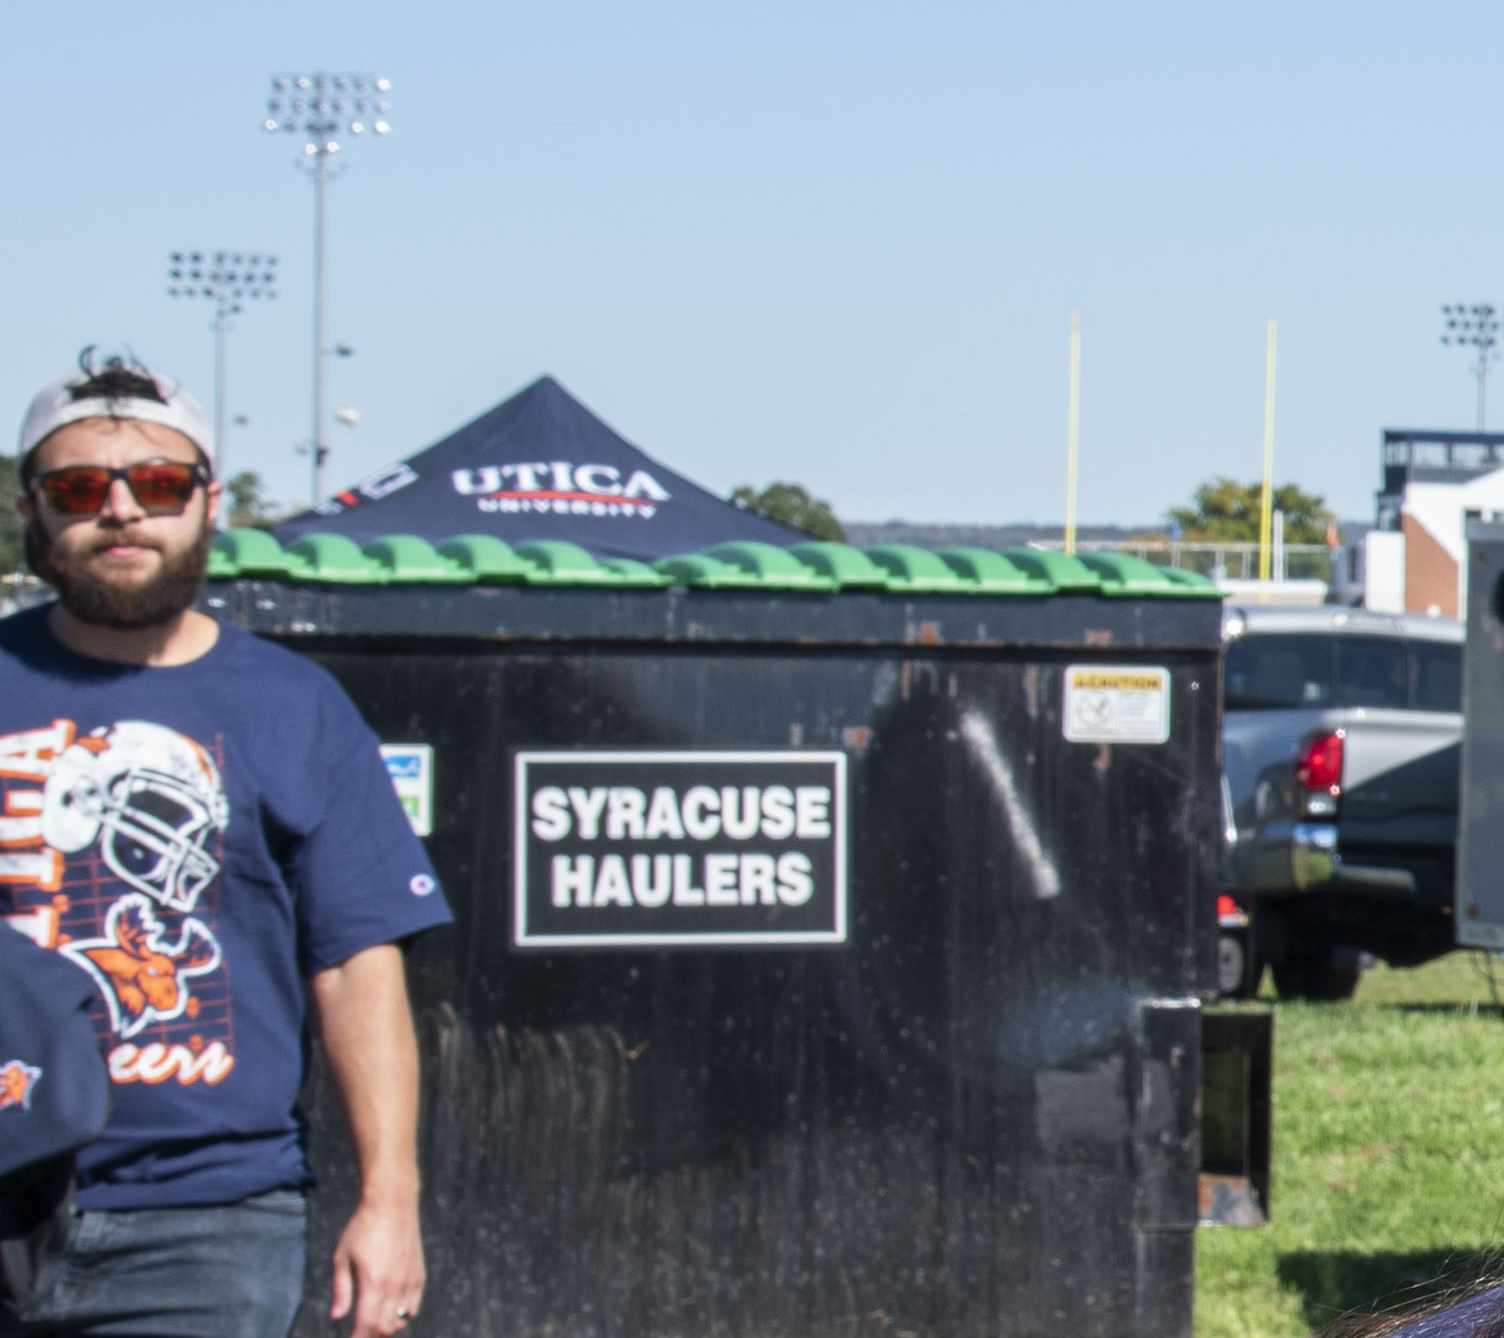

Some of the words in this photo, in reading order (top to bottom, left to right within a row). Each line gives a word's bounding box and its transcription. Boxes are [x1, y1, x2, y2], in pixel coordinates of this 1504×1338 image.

[451, 461, 672, 502] UTICA
[476, 496, 659, 519] UNIVERSITY
[531, 785, 832, 842] SYRACUSE
[552, 852, 815, 908] HAULERS
